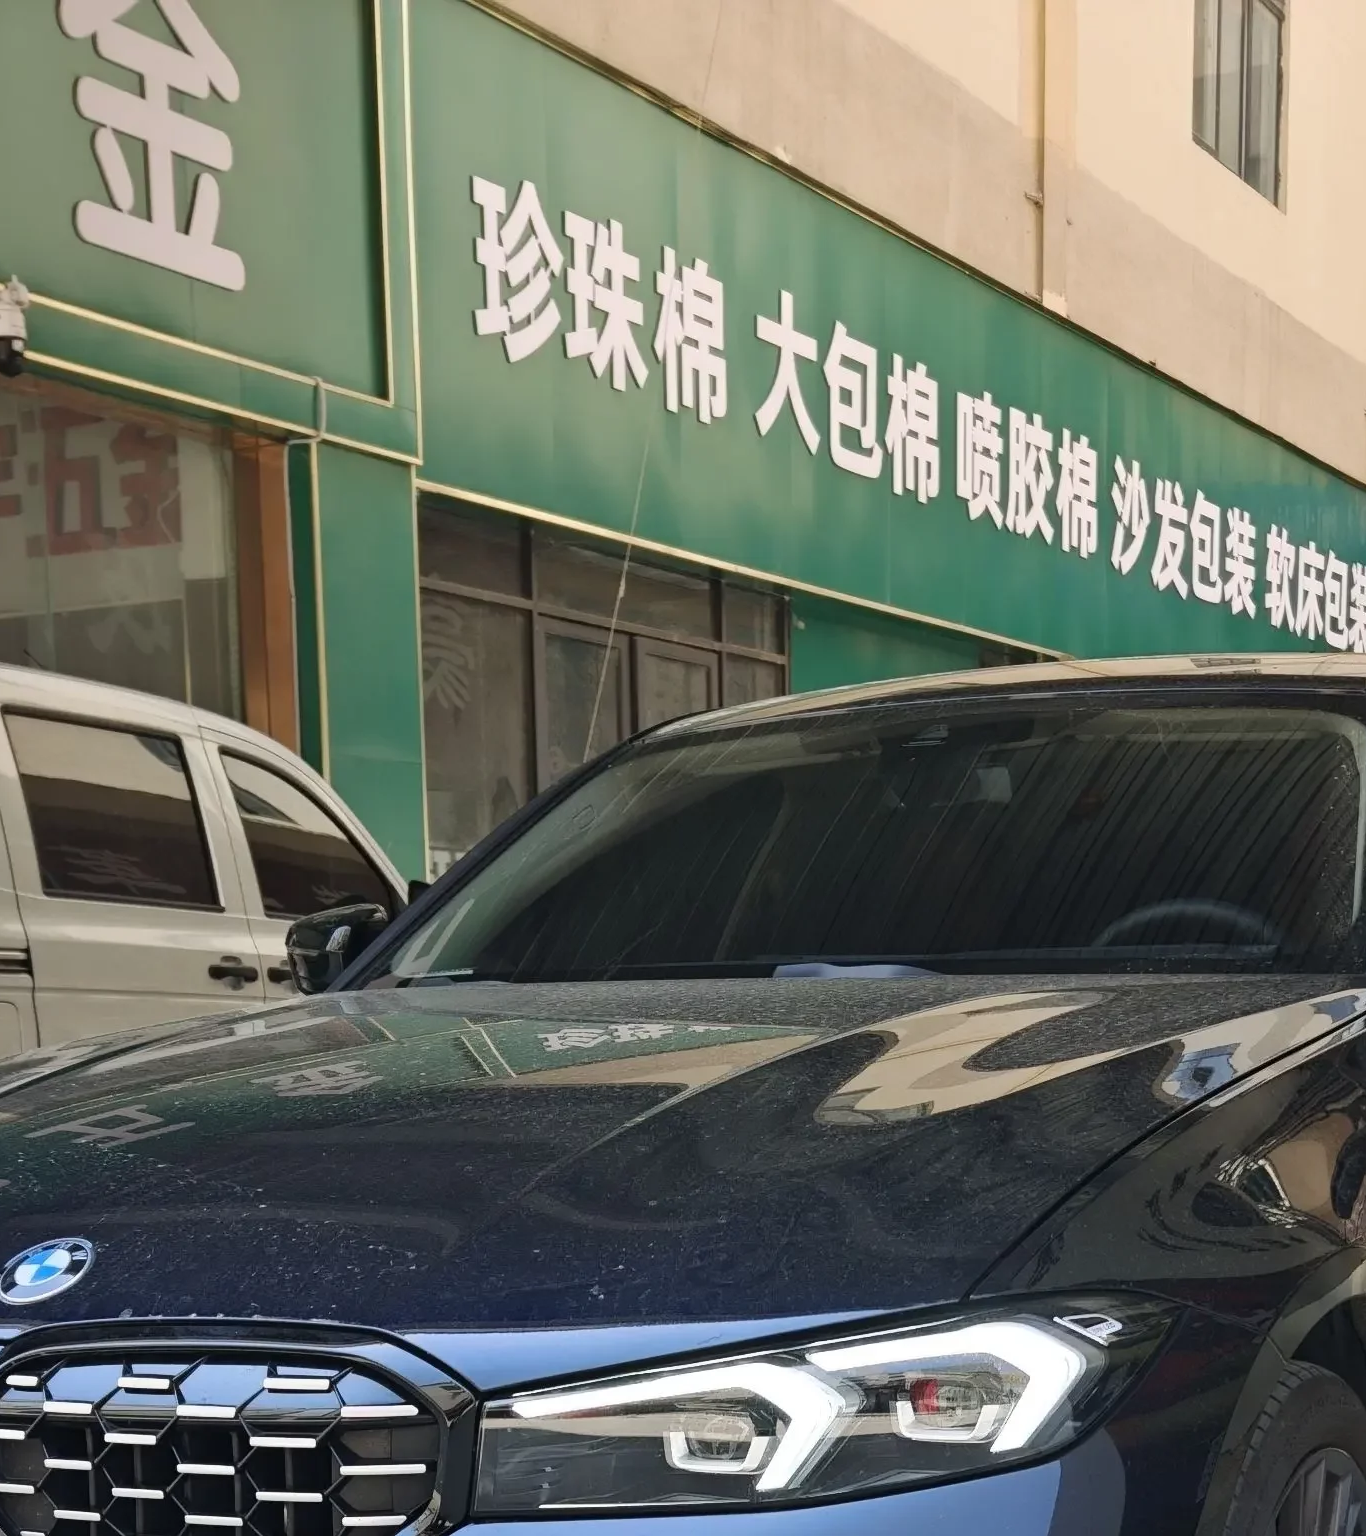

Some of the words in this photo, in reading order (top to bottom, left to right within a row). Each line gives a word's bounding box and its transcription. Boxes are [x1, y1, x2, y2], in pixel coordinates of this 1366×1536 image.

[471, 174, 728, 425] 珍珠棉
[754, 288, 939, 505] 大包棉
[956, 391, 1099, 560] 喷胶棉
[1110, 453, 1257, 620] 沙发包装
